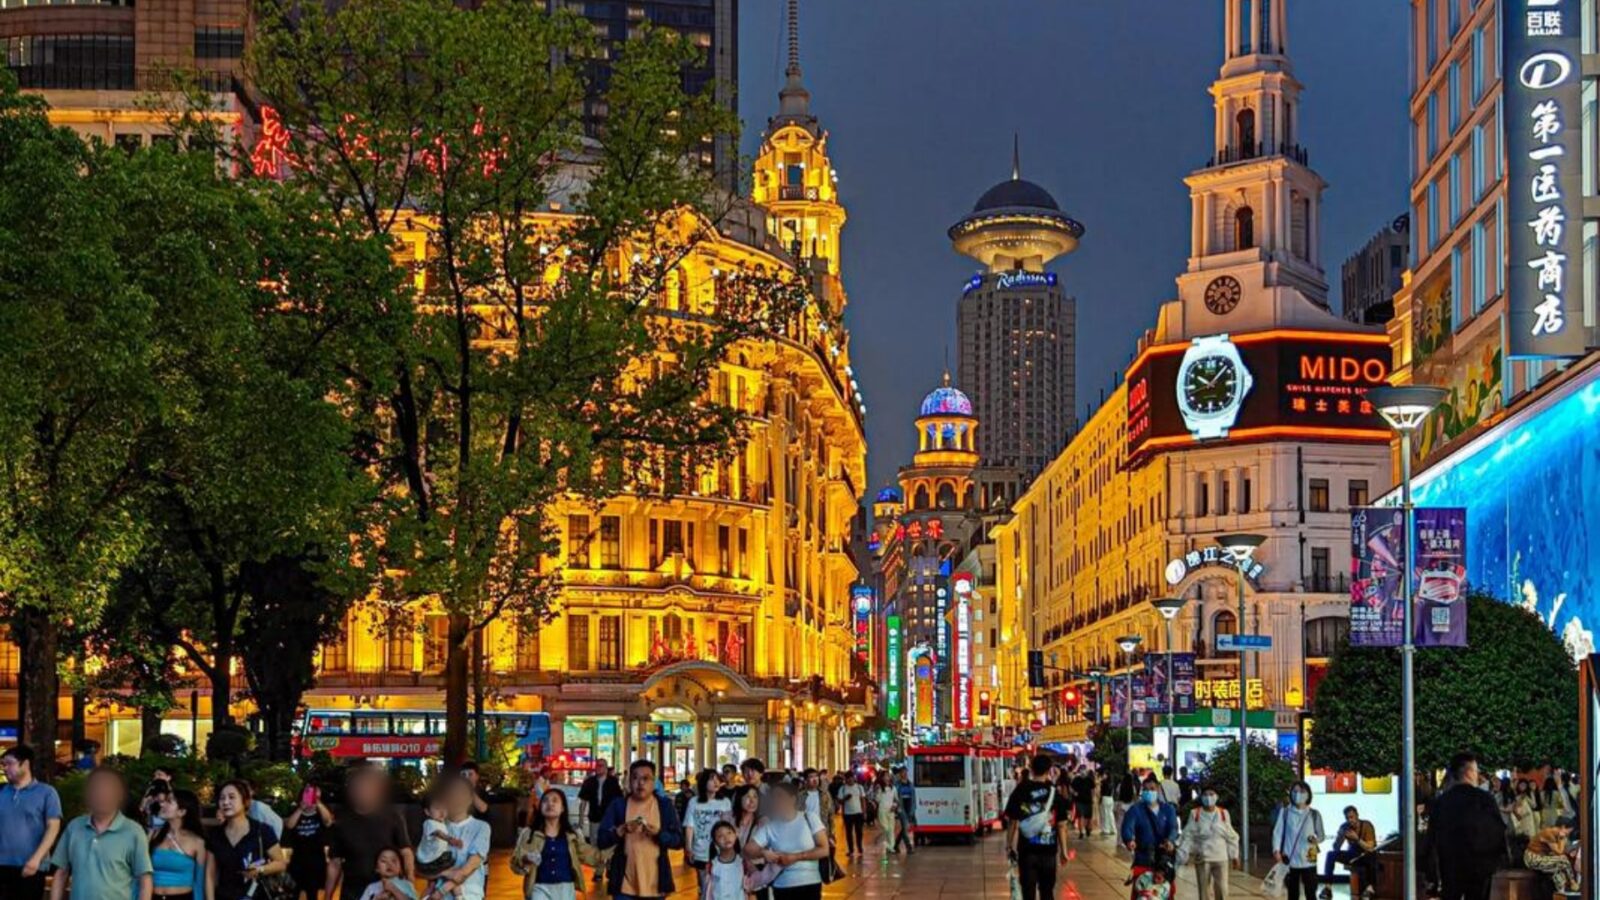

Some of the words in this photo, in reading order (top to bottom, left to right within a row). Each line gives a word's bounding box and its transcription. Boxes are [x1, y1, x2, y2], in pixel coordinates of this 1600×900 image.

[1527, 11, 1562, 28] 百联
[1527, 100, 1567, 336] 第一医药商店
[996, 269, 1048, 290] Radisson
[1300, 355, 1386, 383] MIDO
[1286, 383, 1312, 393] SWISS
[1195, 679, 1262, 699] 时装商店
